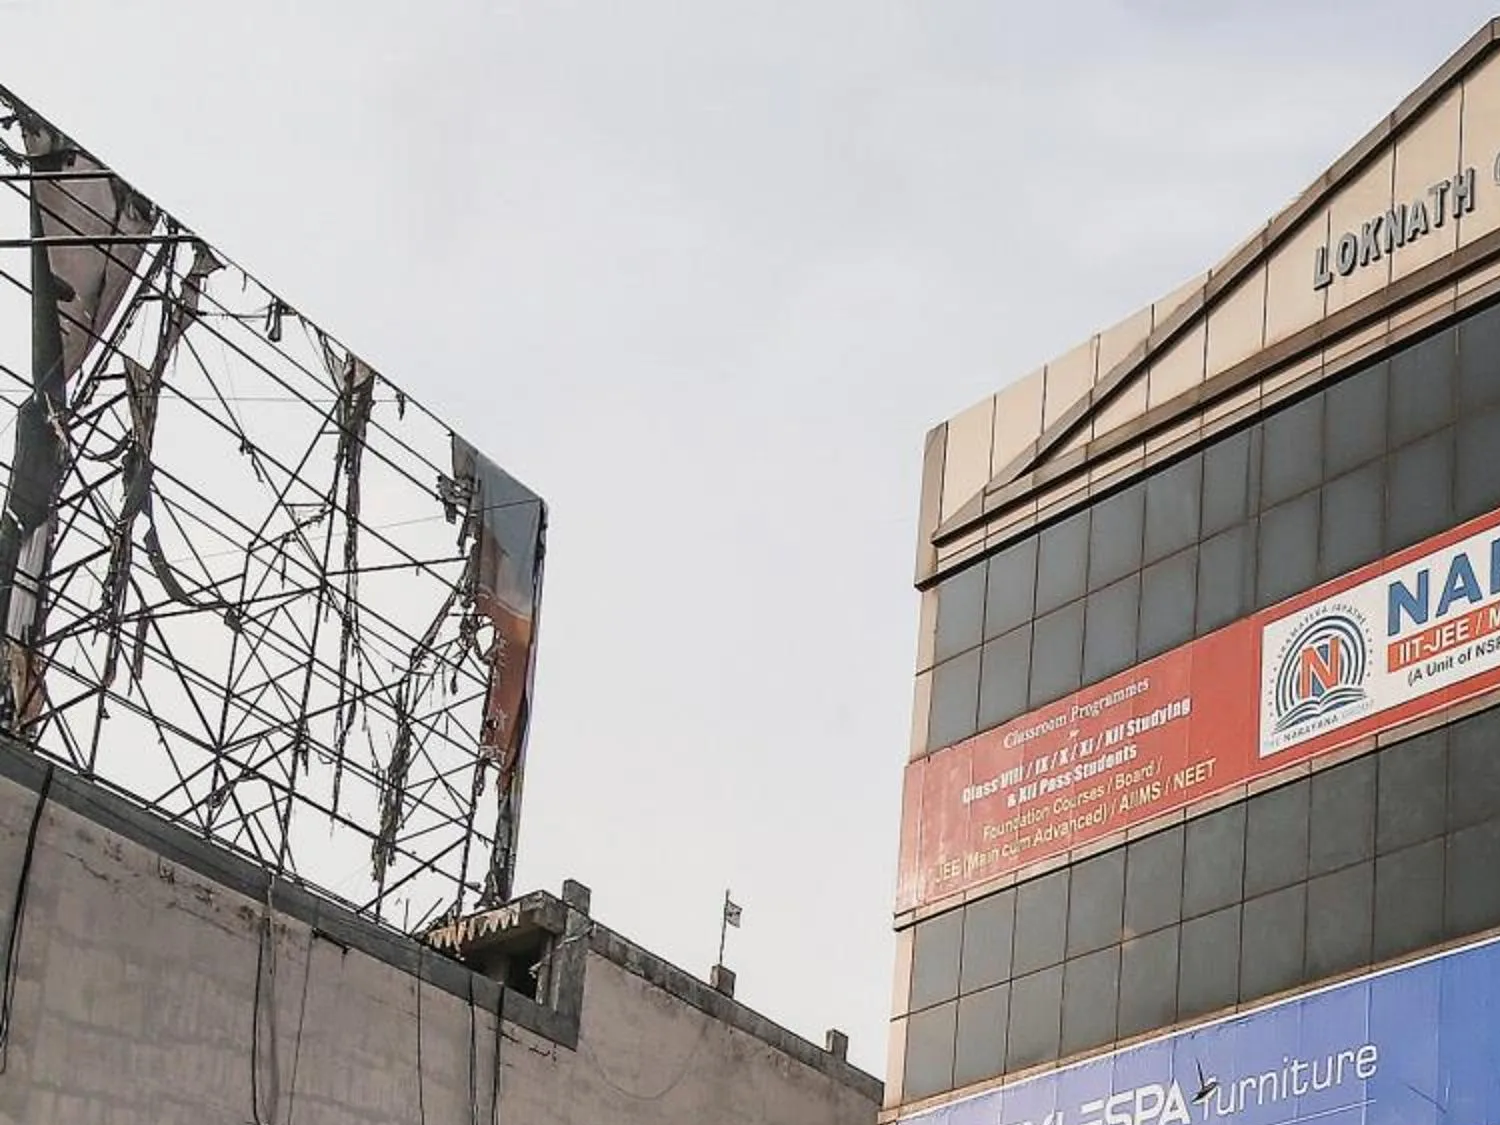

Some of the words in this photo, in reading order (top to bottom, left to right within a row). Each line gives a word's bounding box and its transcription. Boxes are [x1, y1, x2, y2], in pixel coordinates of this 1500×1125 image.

[1314, 167, 1475, 289] LOKNATH
[1401, 617, 1469, 664] IIT-JEE
[1408, 667, 1423, 687] (A
[1427, 656, 1453, 678] Unit
[1458, 649, 1472, 666] of
[1004, 713, 1067, 748] Classroom
[1070, 678, 1151, 722] Programmes
[1126, 698, 1192, 737] Studying
[983, 806, 1049, 841] Foundation
[1053, 786, 1104, 815] Courses
[1115, 760, 1154, 790] Board
[1033, 803, 1108, 847] Advanced)
[1174, 758, 1217, 790] NEET
[1039, 773, 1073, 795] Pass
[1073, 744, 1137, 782] Students
[1202, 1043, 1378, 1122] furniture
